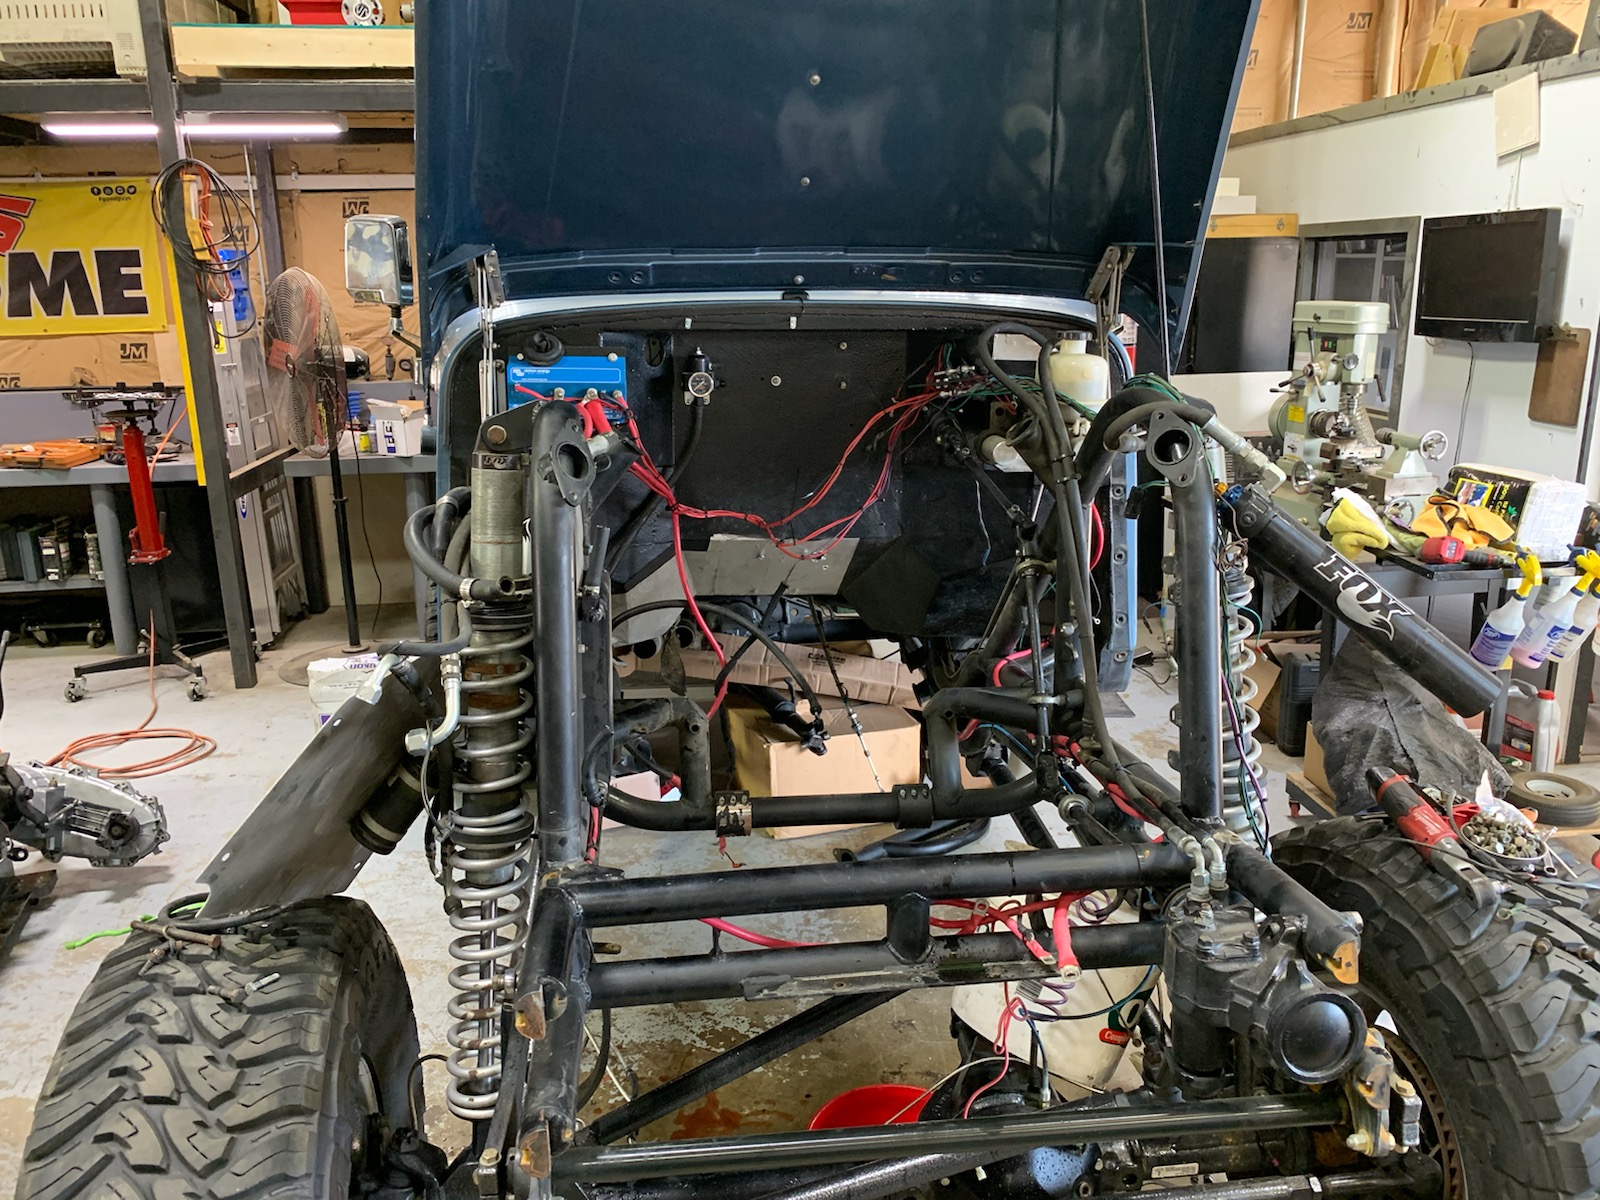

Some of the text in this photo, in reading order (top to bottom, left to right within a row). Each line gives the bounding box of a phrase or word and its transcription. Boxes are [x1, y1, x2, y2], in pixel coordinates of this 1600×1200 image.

[1347, 12, 1373, 29] JM
[0, 249, 149, 317] ME
[120, 343, 147, 359] JM
[1313, 550, 1414, 636] FOX
